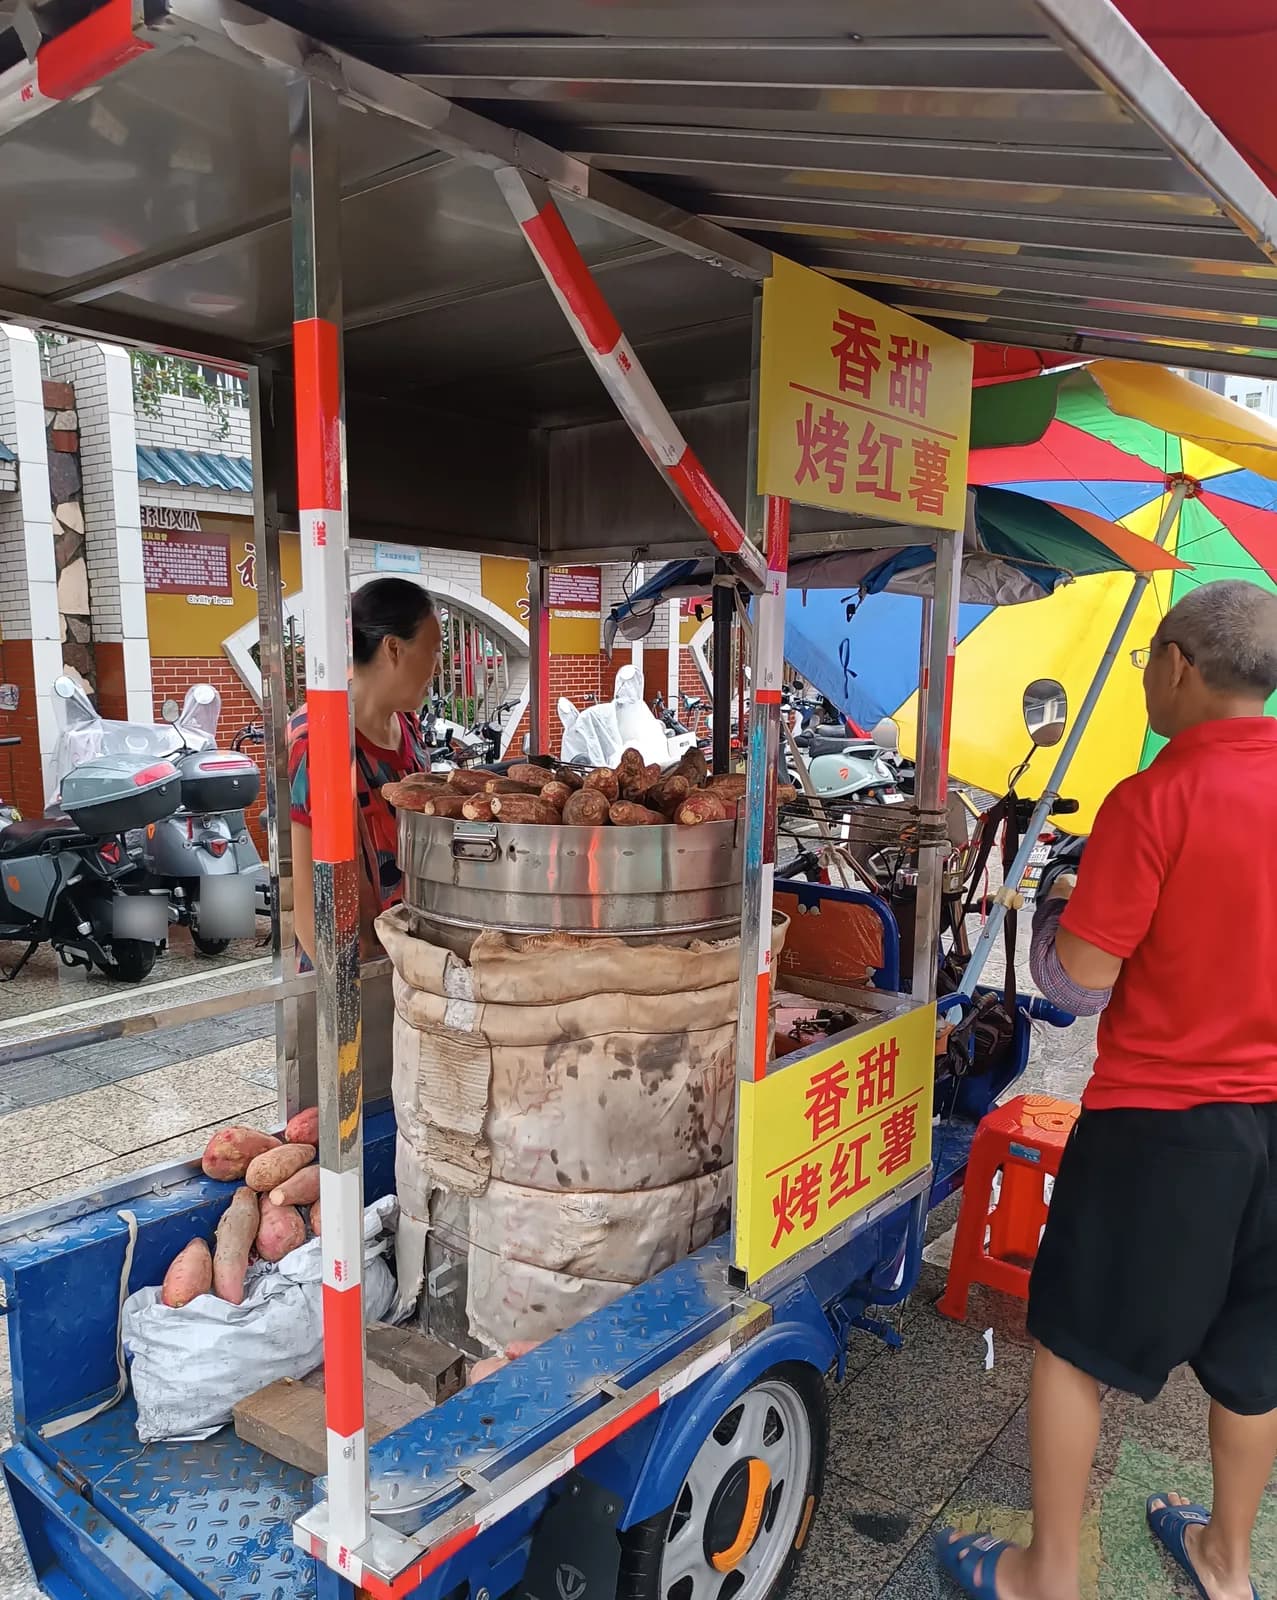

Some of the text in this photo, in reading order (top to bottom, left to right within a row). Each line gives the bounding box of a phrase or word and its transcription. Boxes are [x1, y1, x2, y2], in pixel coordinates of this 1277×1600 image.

[830, 308, 933, 418] 香甜
[794, 402, 951, 516] 烤红薯
[316, 520, 327, 547] 3M
[804, 1037, 900, 1142] 香甜
[770, 1103, 918, 1249] 烤红薯
[334, 1259, 342, 1283] 3M
[338, 1545, 348, 1569] 3M
